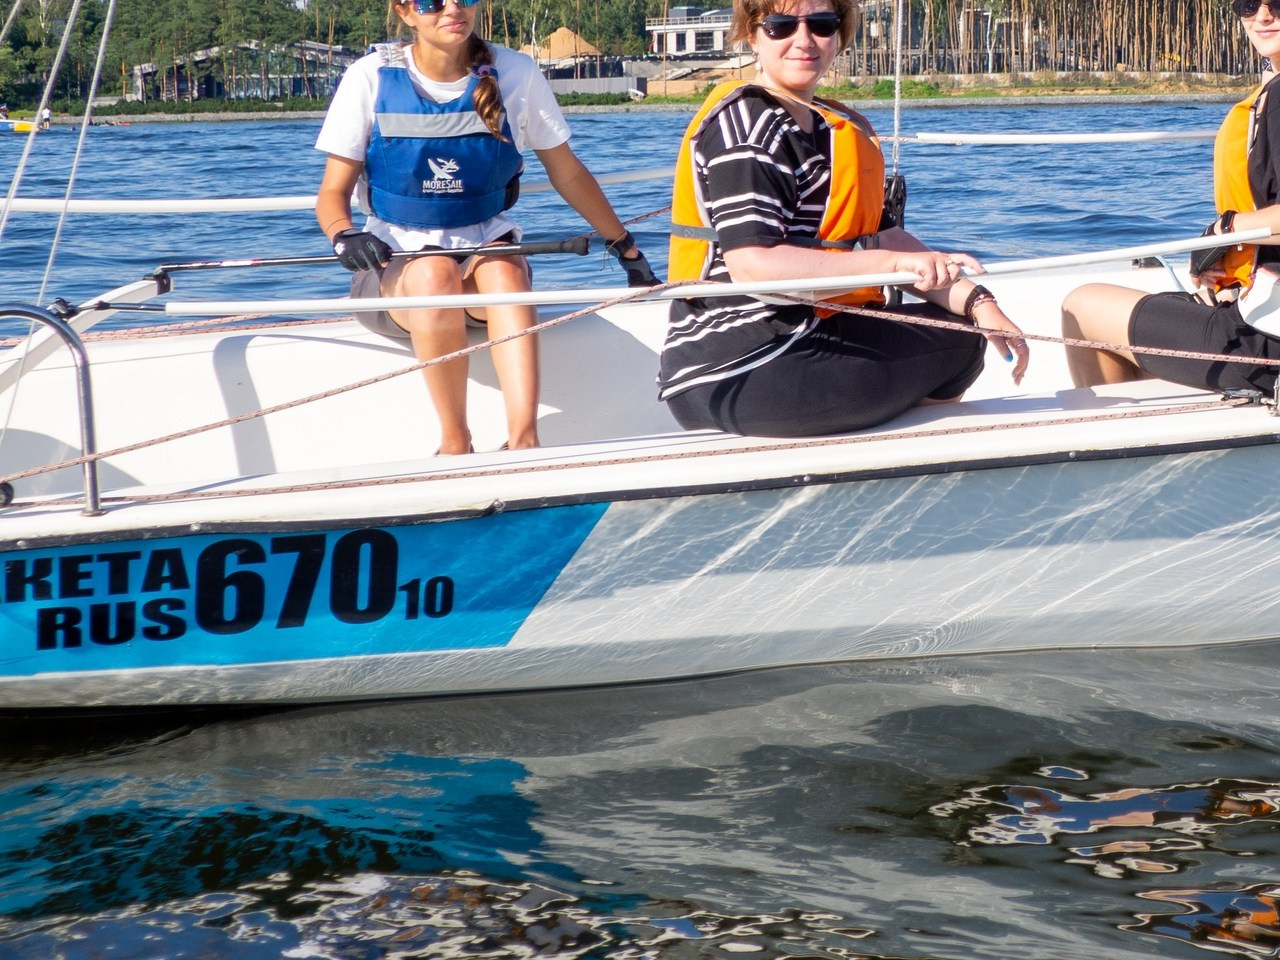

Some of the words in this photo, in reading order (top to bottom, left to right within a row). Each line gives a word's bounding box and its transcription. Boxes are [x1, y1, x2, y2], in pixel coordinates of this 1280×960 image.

[422, 179, 463, 189] MORESAIL
[0, 547, 190, 603] КЕТА
[194, 528, 399, 635] 670
[398, 575, 455, 620] 10
[36, 597, 188, 650] RUS
